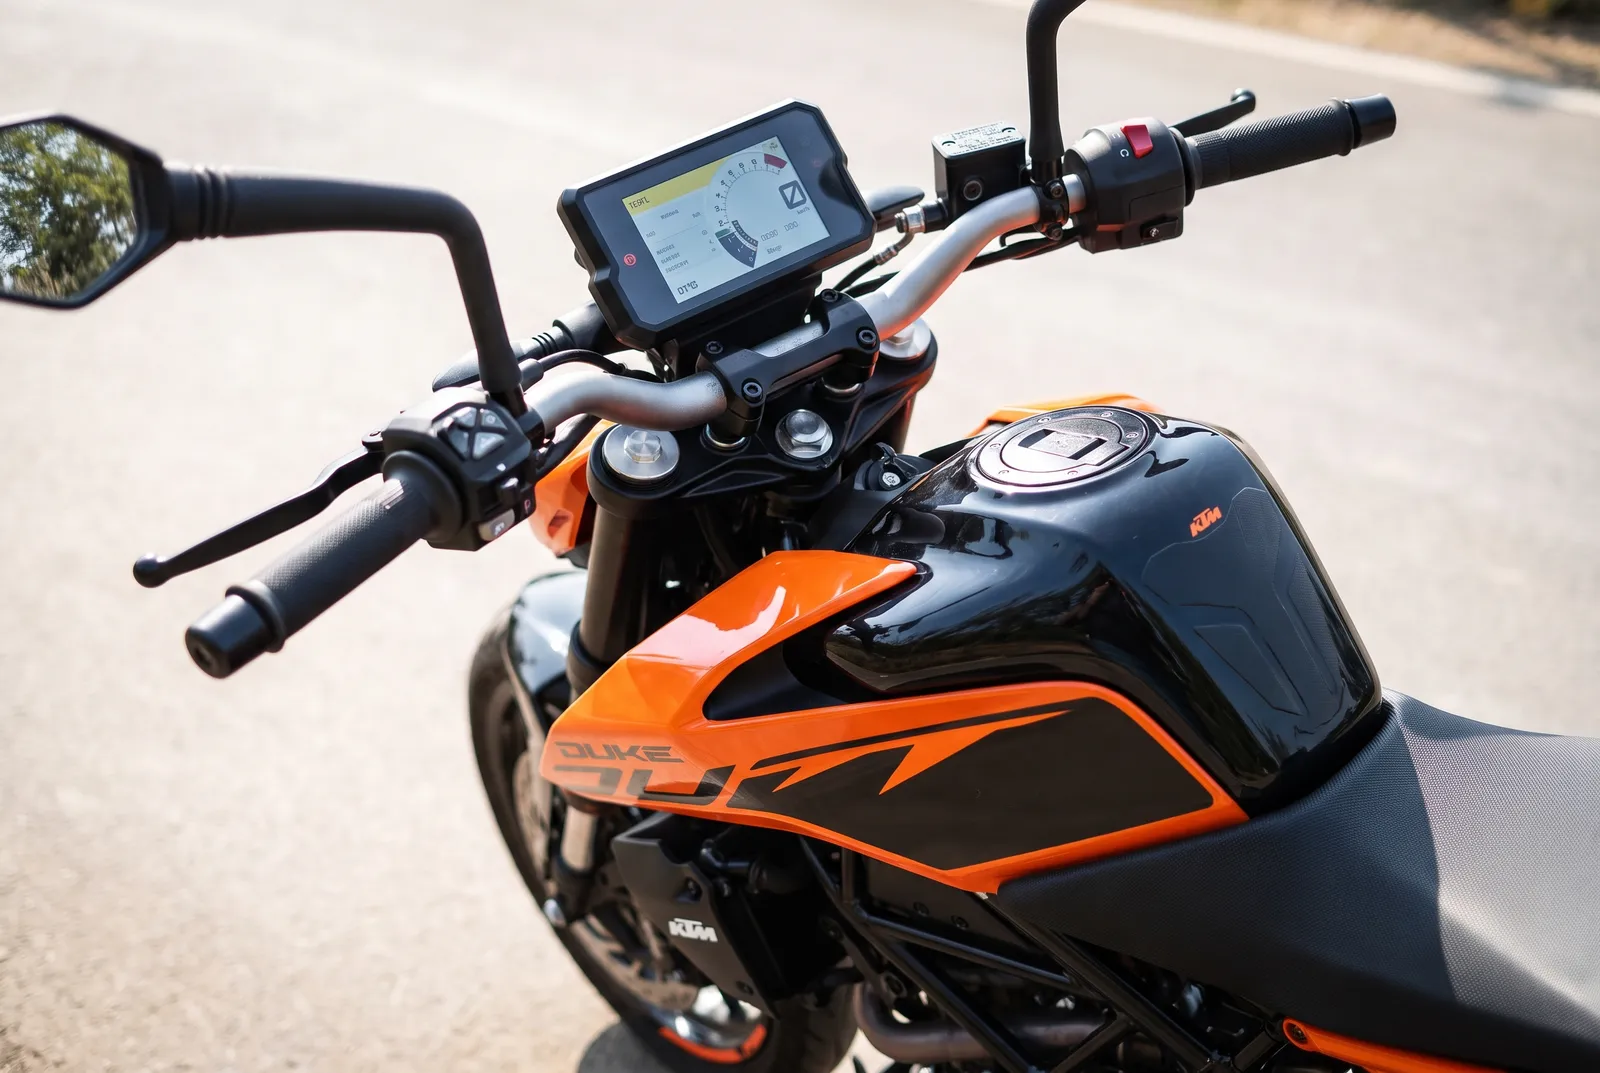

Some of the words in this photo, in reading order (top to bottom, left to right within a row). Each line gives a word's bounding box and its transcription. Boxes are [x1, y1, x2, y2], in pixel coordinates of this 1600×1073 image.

[1190, 506, 1223, 538] KTM
[554, 741, 684, 763] DUKE
[668, 917, 718, 943] KTM
